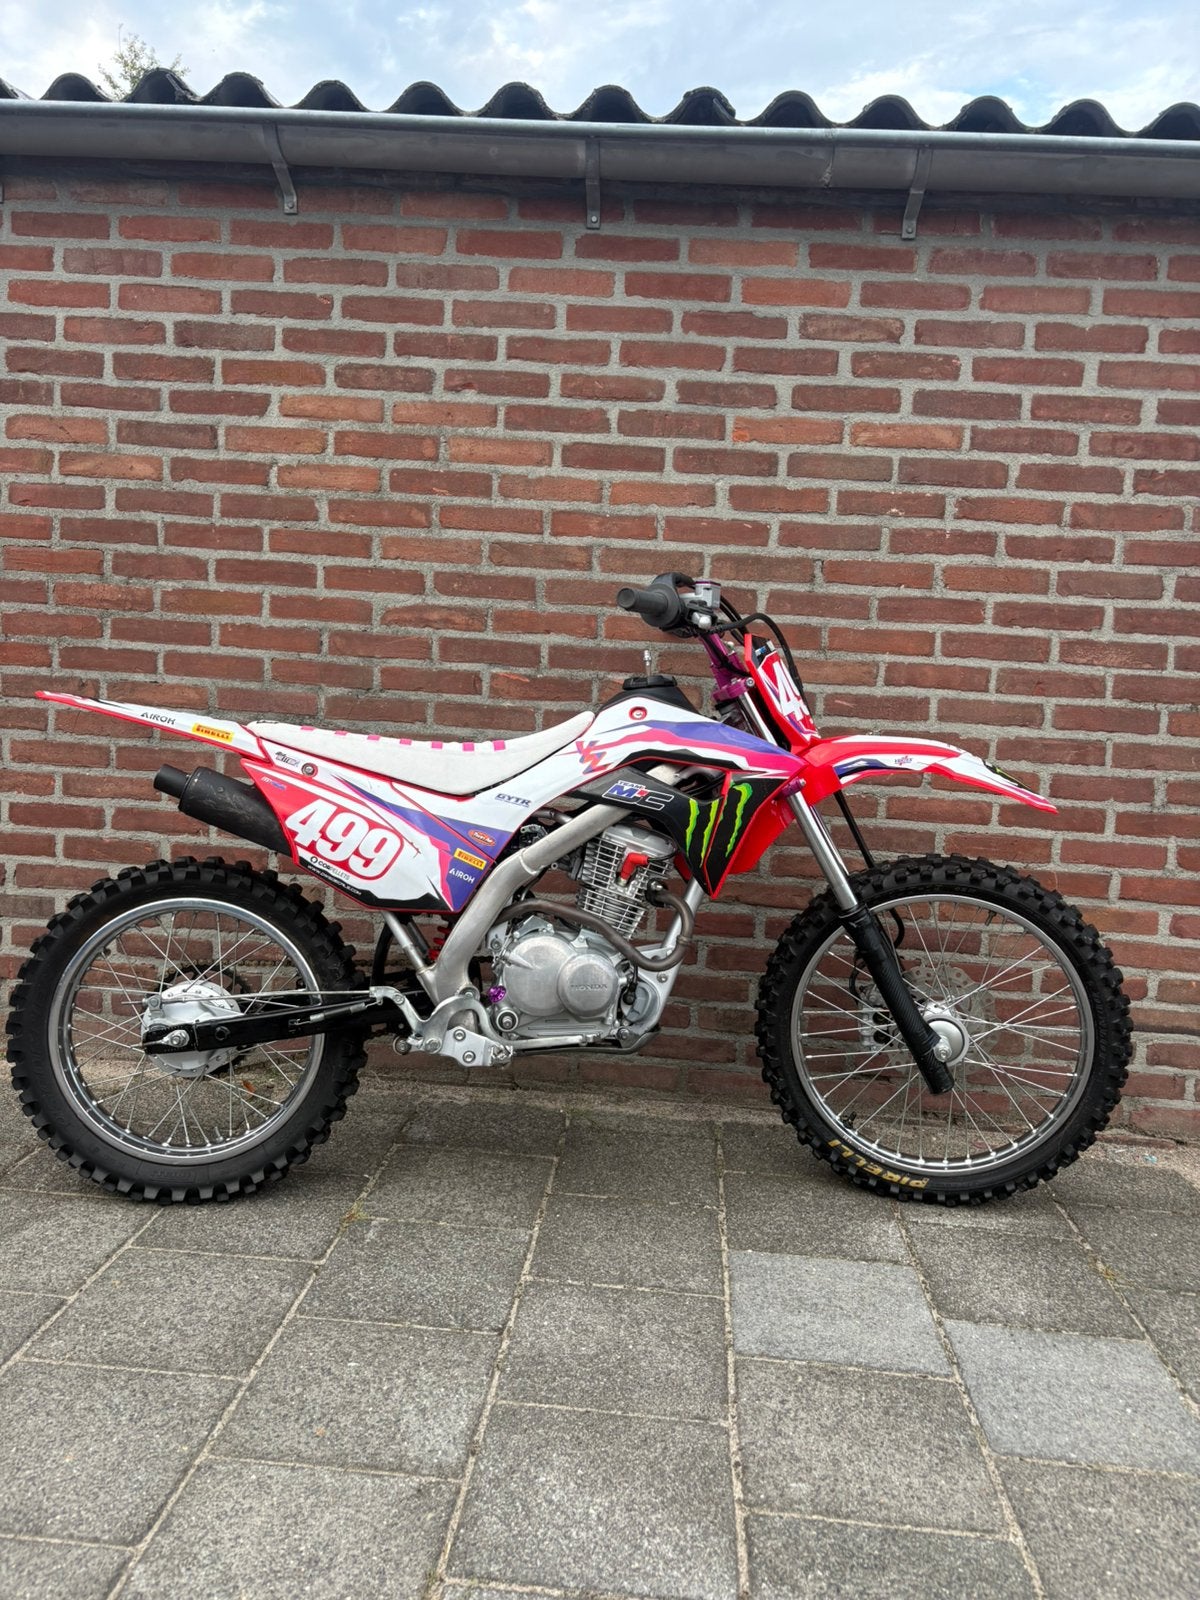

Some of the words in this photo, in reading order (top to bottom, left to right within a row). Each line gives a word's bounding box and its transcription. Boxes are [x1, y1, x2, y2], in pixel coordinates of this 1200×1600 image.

[140, 711, 177, 726] AIROH
[496, 793, 532, 806] GYTR
[285, 799, 401, 877] 499
[457, 851, 484, 868] PIRELLI
[449, 867, 476, 884] AIROH
[570, 983, 608, 993] HONDA
[828, 1139, 930, 1189] PIRELLI
